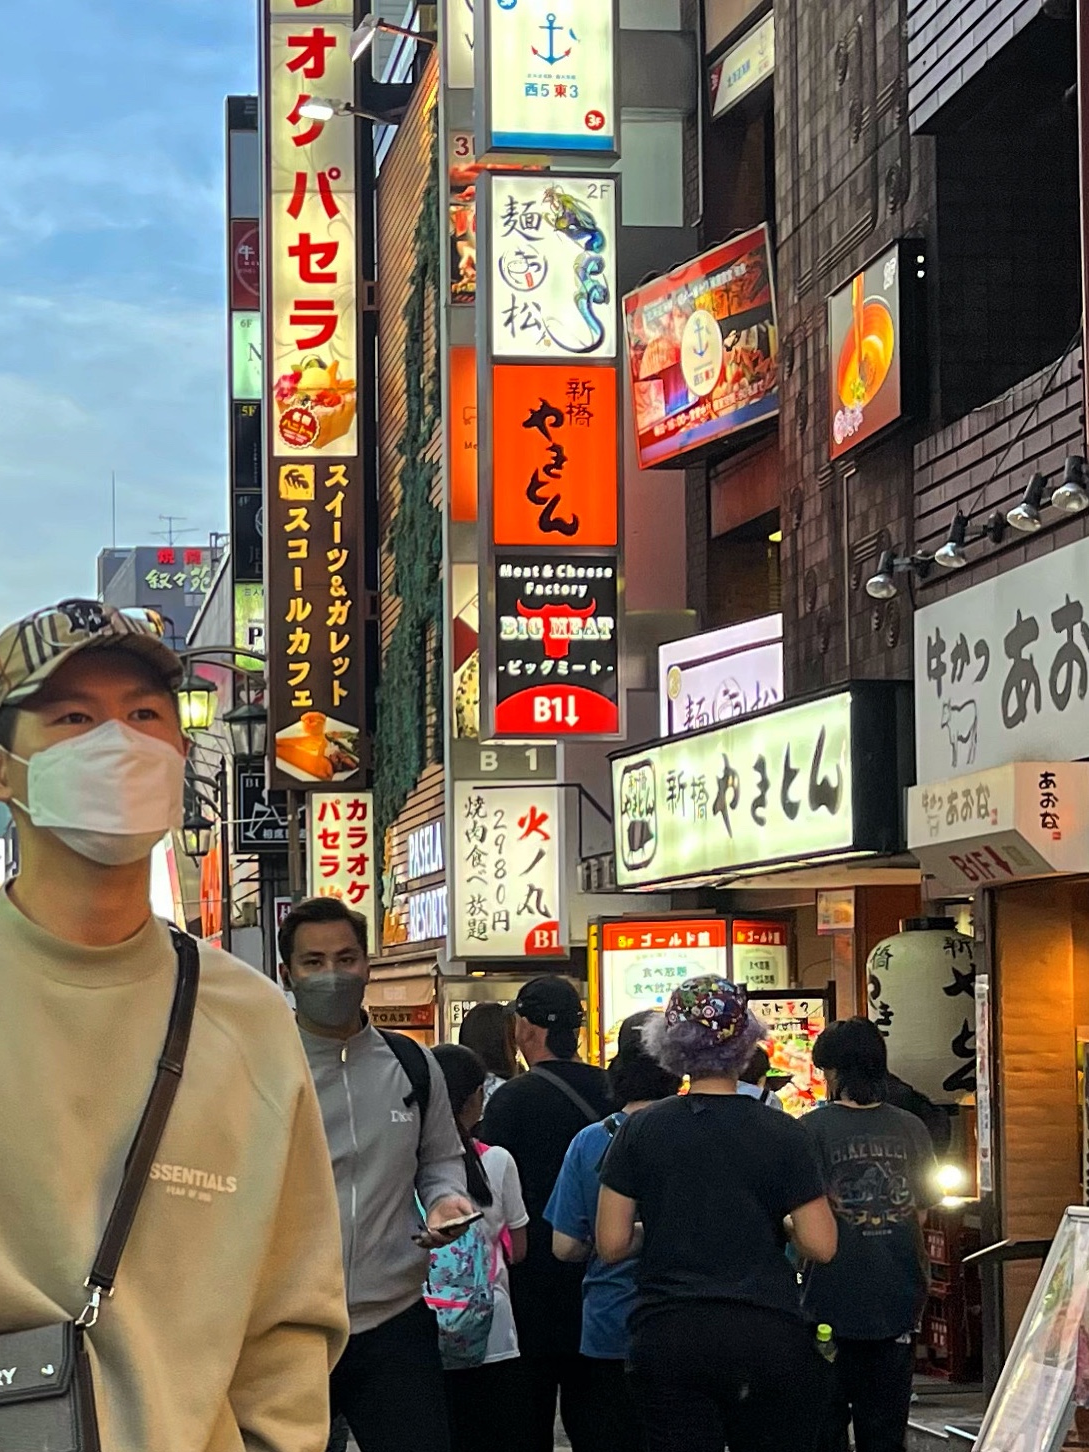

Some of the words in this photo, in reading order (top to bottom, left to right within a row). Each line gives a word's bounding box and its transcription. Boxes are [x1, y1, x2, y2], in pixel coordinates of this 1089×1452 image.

[454, 136, 475, 156] 3
[286, 0, 342, 350] オケパセラ
[587, 184, 611, 200] 2F
[240, 404, 257, 417] 5F
[566, 378, 595, 428] 新橋
[522, 397, 580, 537] やきとん
[499, 564, 541, 579] Meat
[542, 564, 554, 579] &
[556, 563, 613, 580] Cheese
[524, 580, 588, 598] Factory
[283, 506, 313, 708] スコールカフェ
[499, 615, 545, 640] BIG
[549, 616, 614, 640] MEAT
[533, 697, 562, 724] B1
[712, 725, 844, 839] やきとん
[946, 782, 991, 826] あおな
[1038, 770, 1060, 830] あおな
[317, 802, 341, 878] パセラ
[346, 799, 370, 904] カラオケ
[408, 820, 443, 879] PASELA
[516, 805, 551, 920] 火ノ丸
[464, 795, 489, 942] 焼肉食べ放題
[948, 851, 996, 882] B1F
[372, 1011, 412, 1023] TOAST
